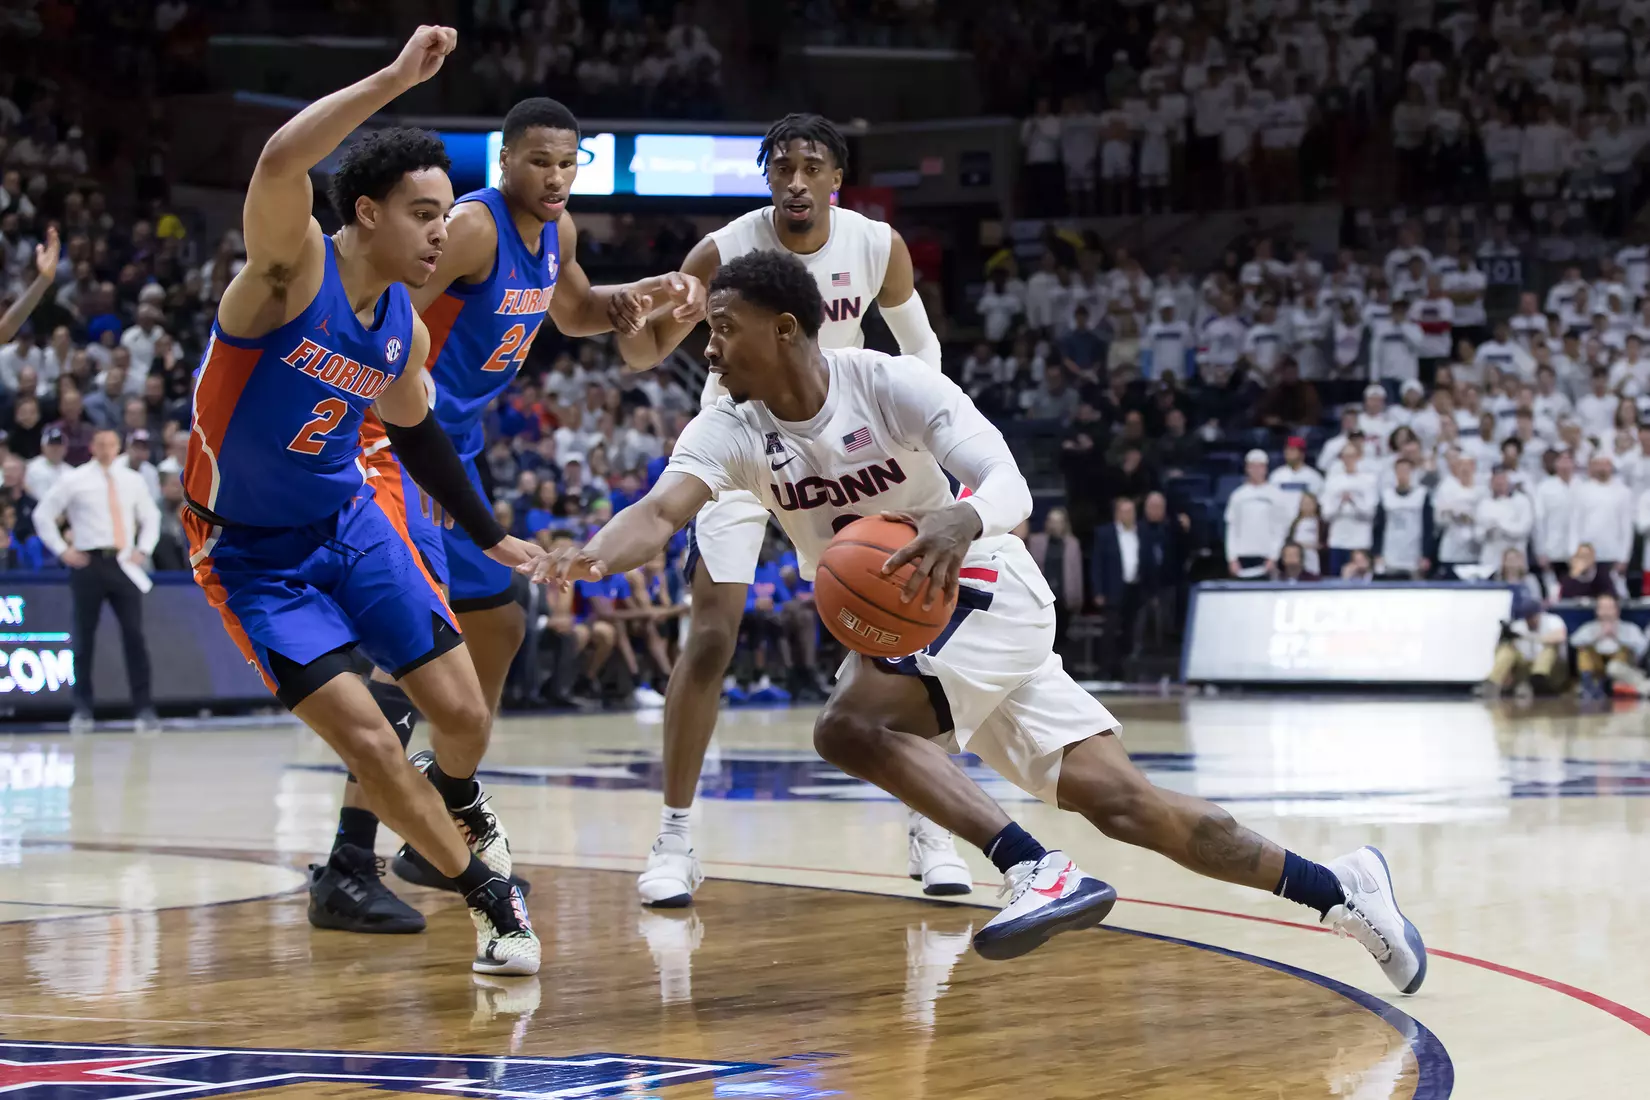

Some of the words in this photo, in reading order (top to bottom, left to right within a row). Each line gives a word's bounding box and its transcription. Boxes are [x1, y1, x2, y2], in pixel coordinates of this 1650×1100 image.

[386, 338, 402, 362] SEC
[286, 397, 348, 456] 2
[770, 457, 907, 511] UCONN
[837, 607, 901, 648] ELITE
